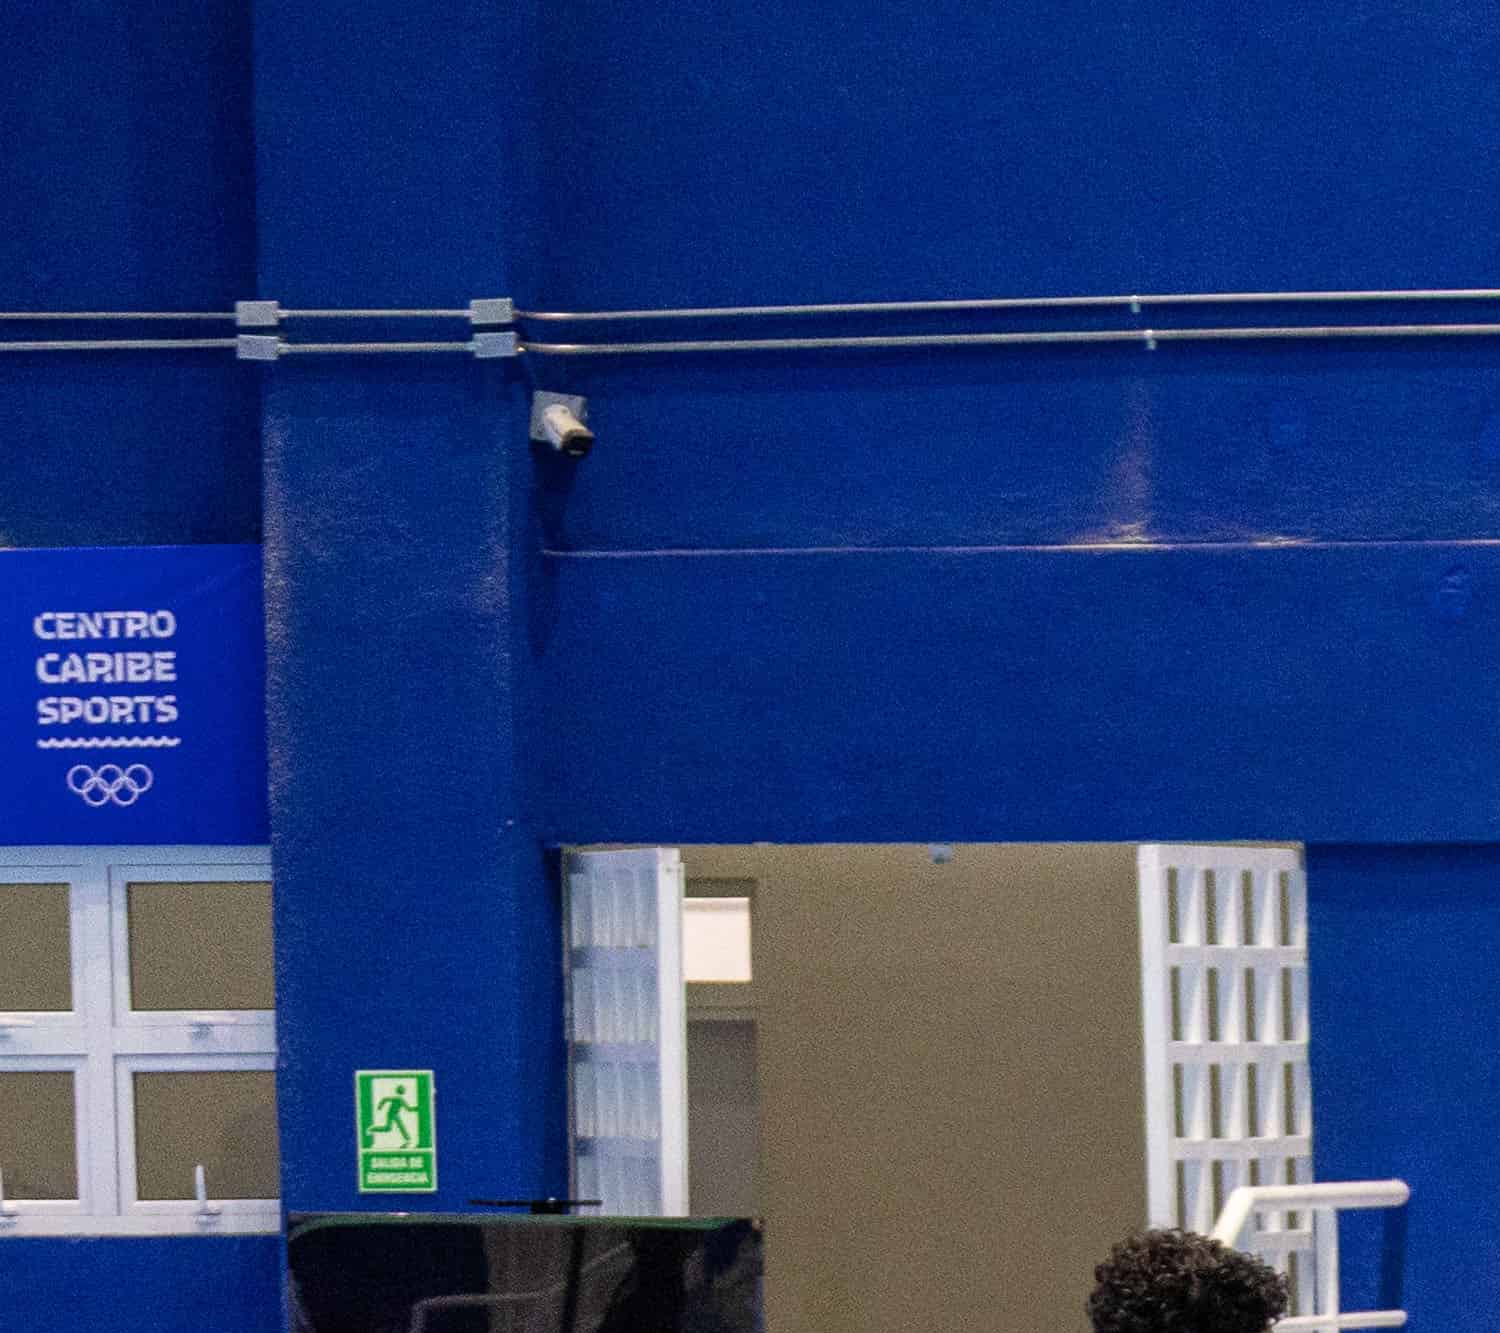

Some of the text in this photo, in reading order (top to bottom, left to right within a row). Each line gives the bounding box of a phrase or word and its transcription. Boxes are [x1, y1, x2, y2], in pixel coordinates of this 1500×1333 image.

[34, 609, 176, 639] CENTRO
[35, 651, 177, 684] CARIBE
[36, 695, 178, 725] SPORTS
